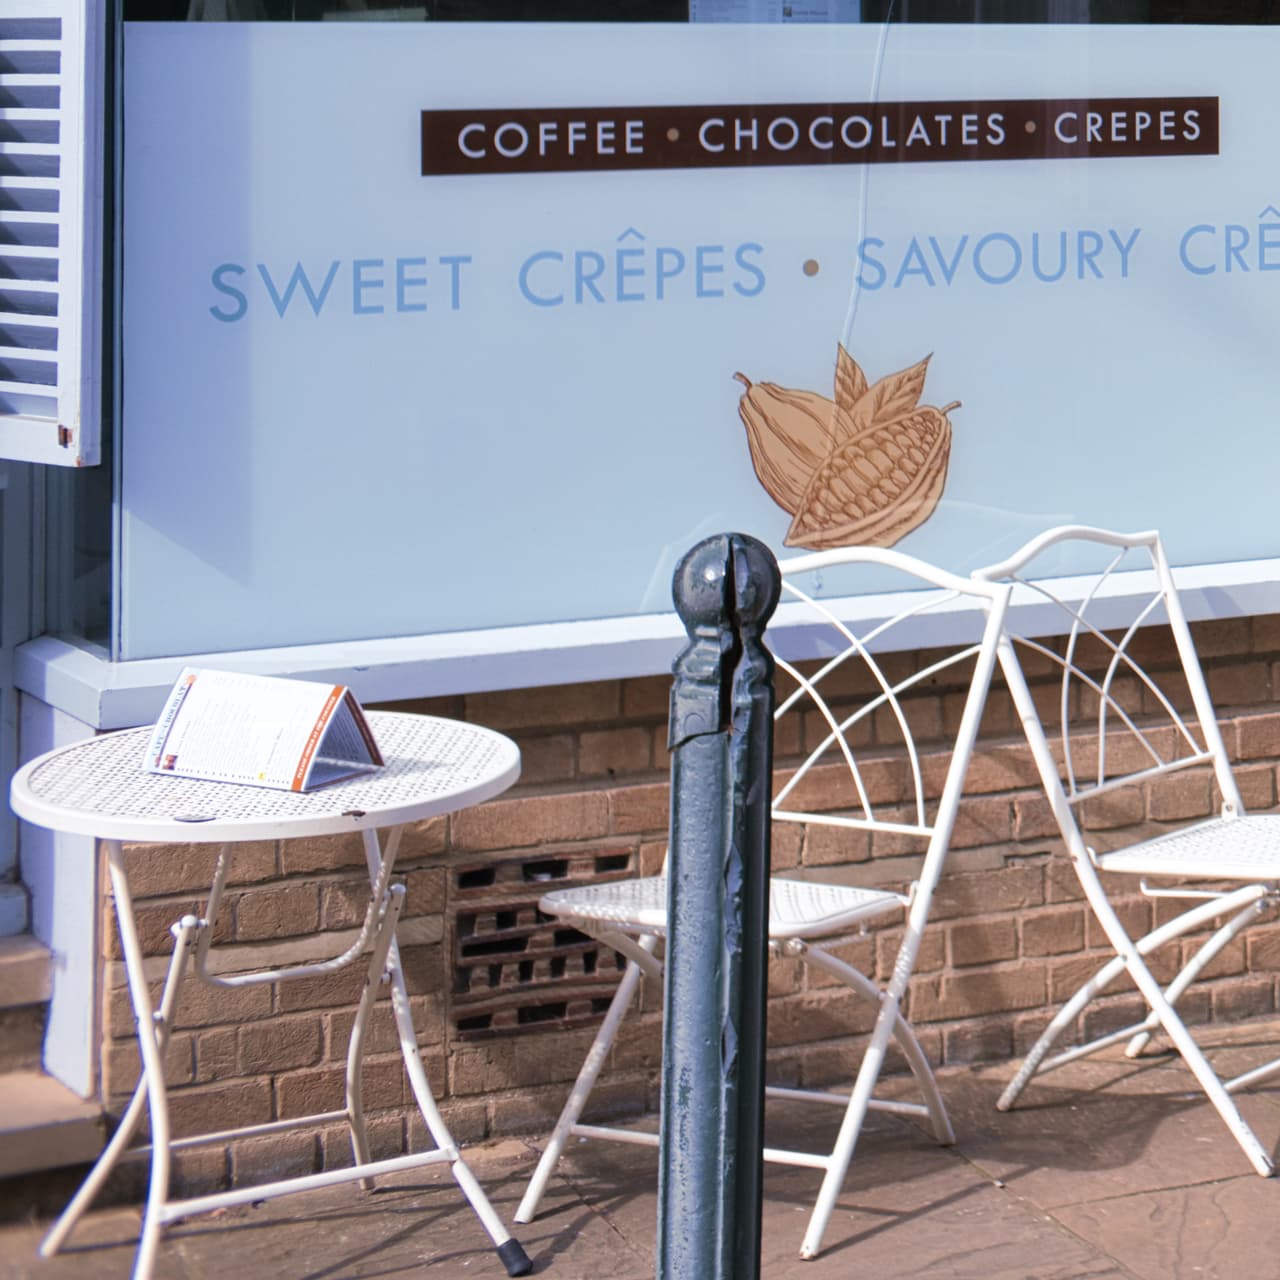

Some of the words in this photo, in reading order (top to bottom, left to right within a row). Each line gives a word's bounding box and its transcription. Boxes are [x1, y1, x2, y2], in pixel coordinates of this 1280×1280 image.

[457, 121, 645, 159] COFFEE
[698, 112, 1006, 155] CHOCOLATES
[1054, 109, 1200, 145] CREPES
[209, 256, 472, 324] SWEET
[517, 227, 767, 308] CRÊPES
[855, 229, 1143, 293] SAVOURY
